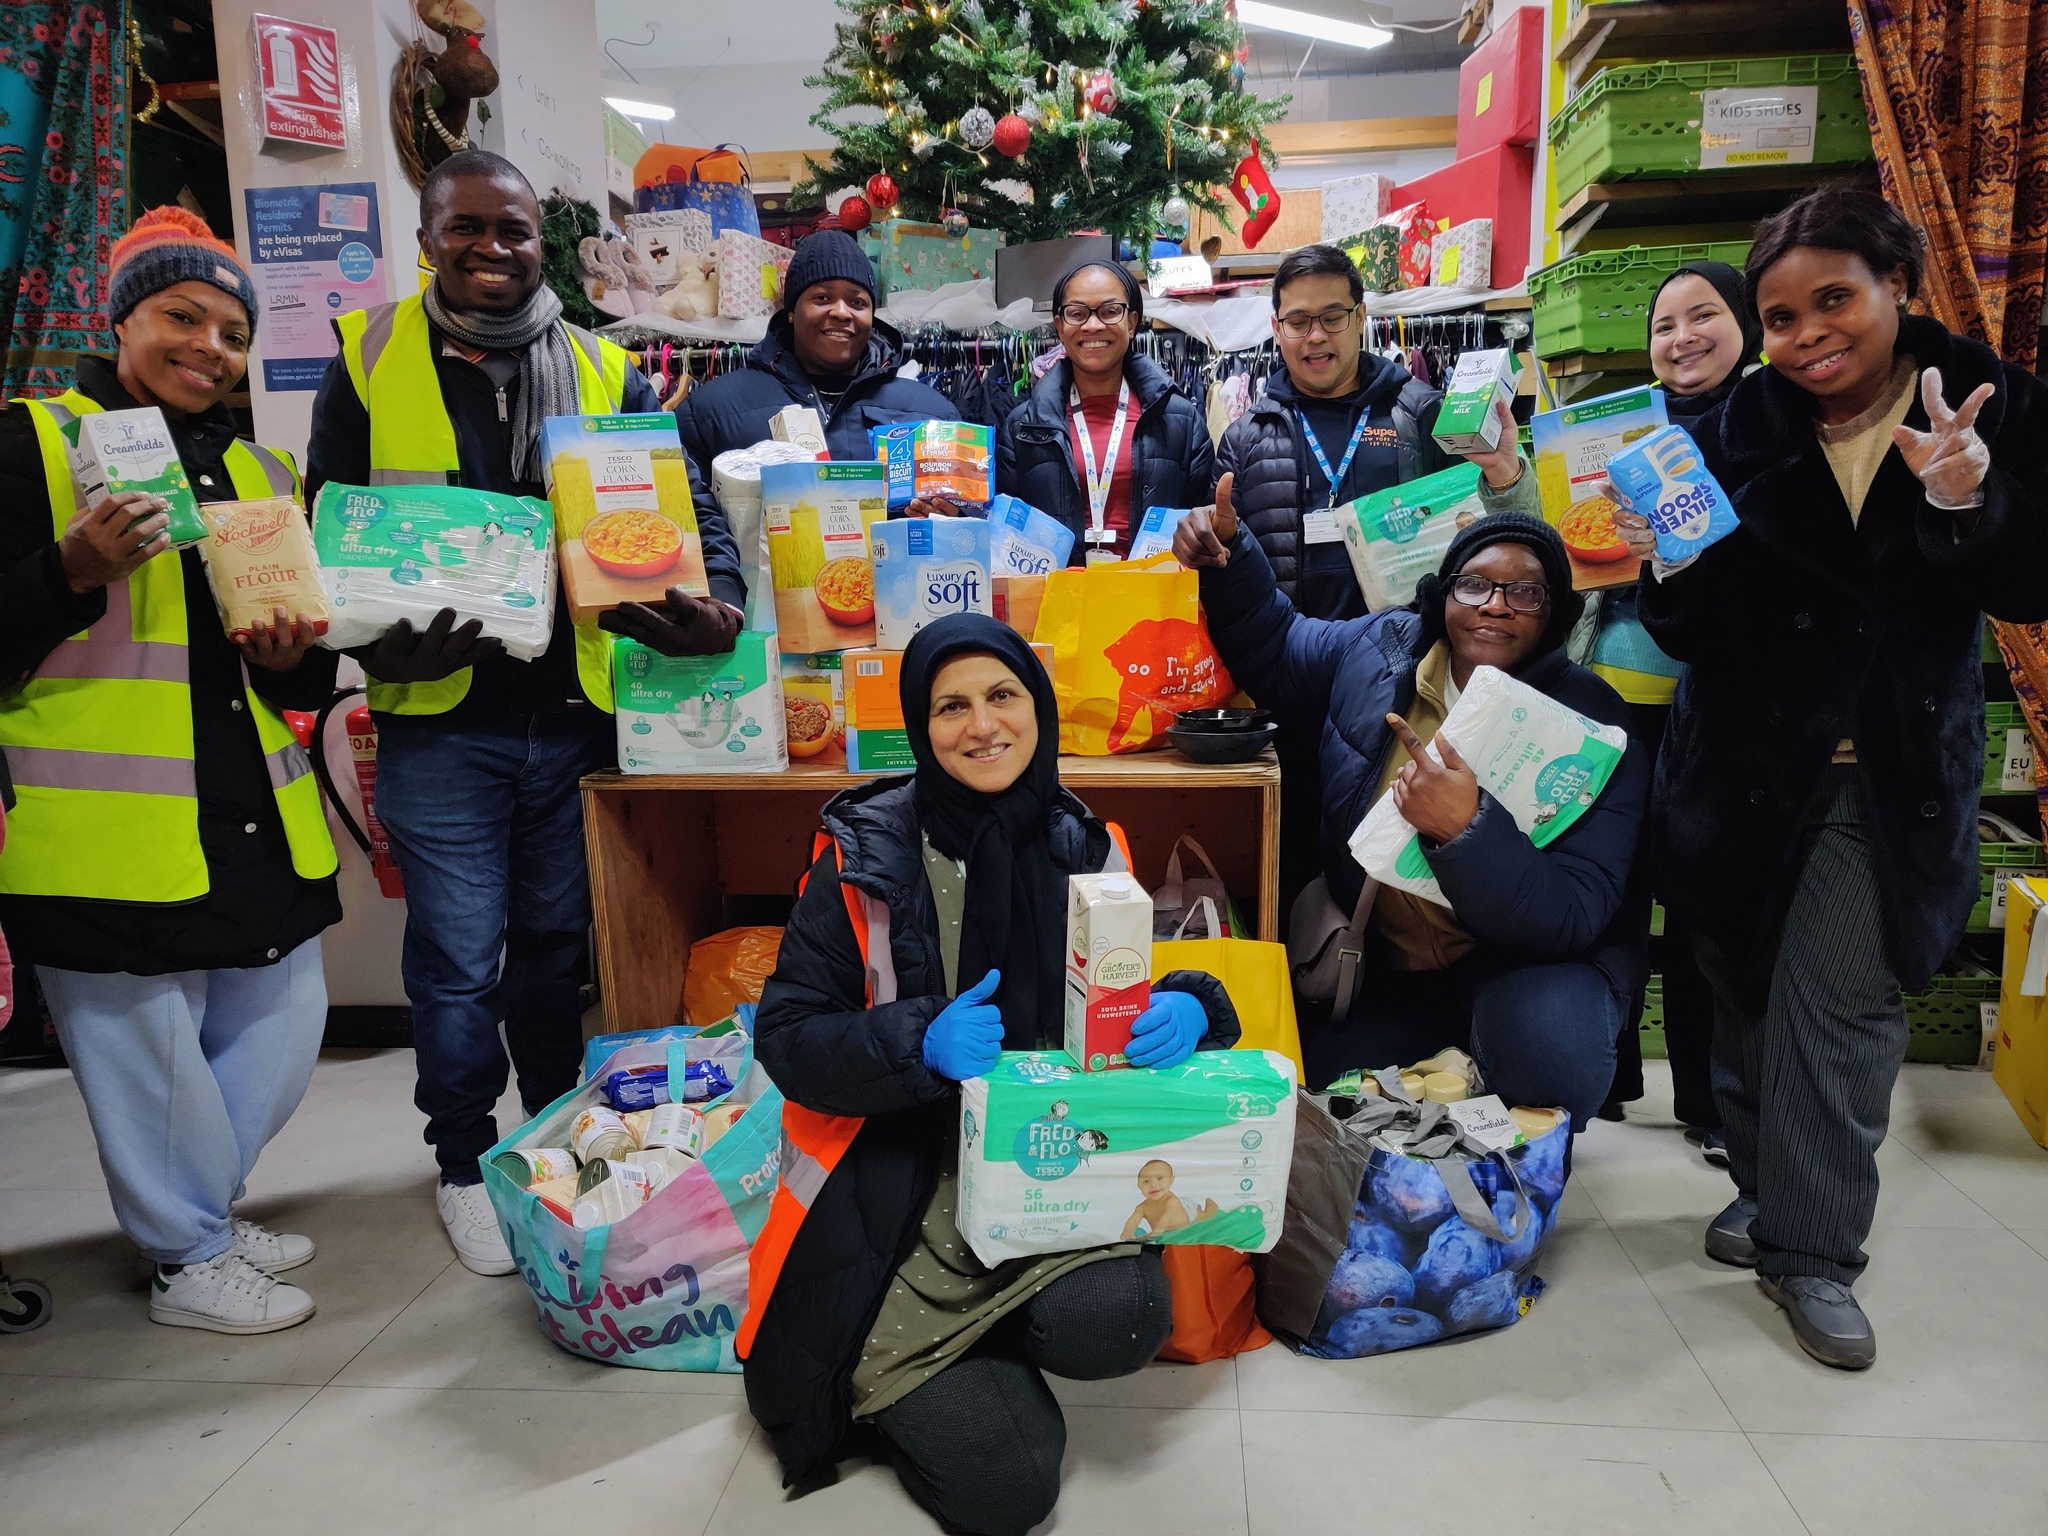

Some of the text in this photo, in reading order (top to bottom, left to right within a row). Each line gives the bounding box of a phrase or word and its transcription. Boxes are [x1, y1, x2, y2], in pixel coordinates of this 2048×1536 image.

[294, 109, 317, 122] Fire
[1720, 103, 1802, 119] KIDS SHOES
[270, 121, 344, 141] extinguisher
[538, 138, 582, 184] Co-working
[1726, 151, 1788, 162] DO NOT REMOVE
[254, 197, 300, 208] Biometric
[256, 210, 302, 220] Residence
[257, 223, 292, 233] Permits
[258, 232, 342, 246] are being replaced
[259, 247, 303, 259] by eVisas
[1457, 367, 1493, 377] Creamfields
[104, 439, 164, 455] Creamfields
[890, 440, 911, 461] 4
[1582, 443, 1605, 452] TESCO
[1581, 451, 1609, 464] CORN
[606, 465, 637, 473] CORN
[889, 462, 911, 470] PACK
[603, 474, 644, 484] FLAKES
[889, 468, 912, 478] BISCUIT
[347, 494, 379, 508] FRED
[1647, 481, 1712, 525] SPOON
[353, 507, 376, 518] FLO
[830, 515, 851, 523] CORN
[1655, 495, 1717, 535] SILVER
[215, 509, 291, 547] Stockwell
[828, 523, 856, 533] FLAKES
[340, 542, 397, 557] ultra dry
[1011, 542, 1039, 561] Luxury
[249, 563, 279, 573] PLAIN
[234, 569, 299, 589] FLOUR
[927, 572, 962, 585] Luxury
[928, 571, 981, 612] soft
[629, 652, 647, 661] FRED
[634, 661, 647, 669] FLO
[1167, 657, 1189, 677] I'm
[1161, 677, 1187, 695] and
[656, 690, 672, 700] dry
[1531, 747, 1545, 764] 48
[1498, 742, 1536, 793] ultra dry
[2011, 758, 2030, 769] EU
[1538, 764, 1559, 787] TESCO
[1551, 772, 1574, 798] FLO
[1560, 769, 1591, 805] FRED
[1998, 896, 2006, 907] E
[1101, 963, 1141, 974] GROWER'S
[1102, 971, 1140, 981] HARVEST
[1097, 1010, 1141, 1019] UNSWEETENED
[1987, 1041, 1996, 1051] E
[1237, 1098, 1249, 1117] 3
[1467, 1118, 1510, 1133] Creamfields
[1029, 1123, 1075, 1143] FRED
[1039, 1142, 1071, 1160] FLO
[1035, 1166, 1065, 1175] TESCO
[1025, 1189, 1043, 1200] 56
[1023, 1200, 1089, 1213] ultra dry
[1022, 1215, 1069, 1226] nappies
[582, 1304, 735, 1357] clean
